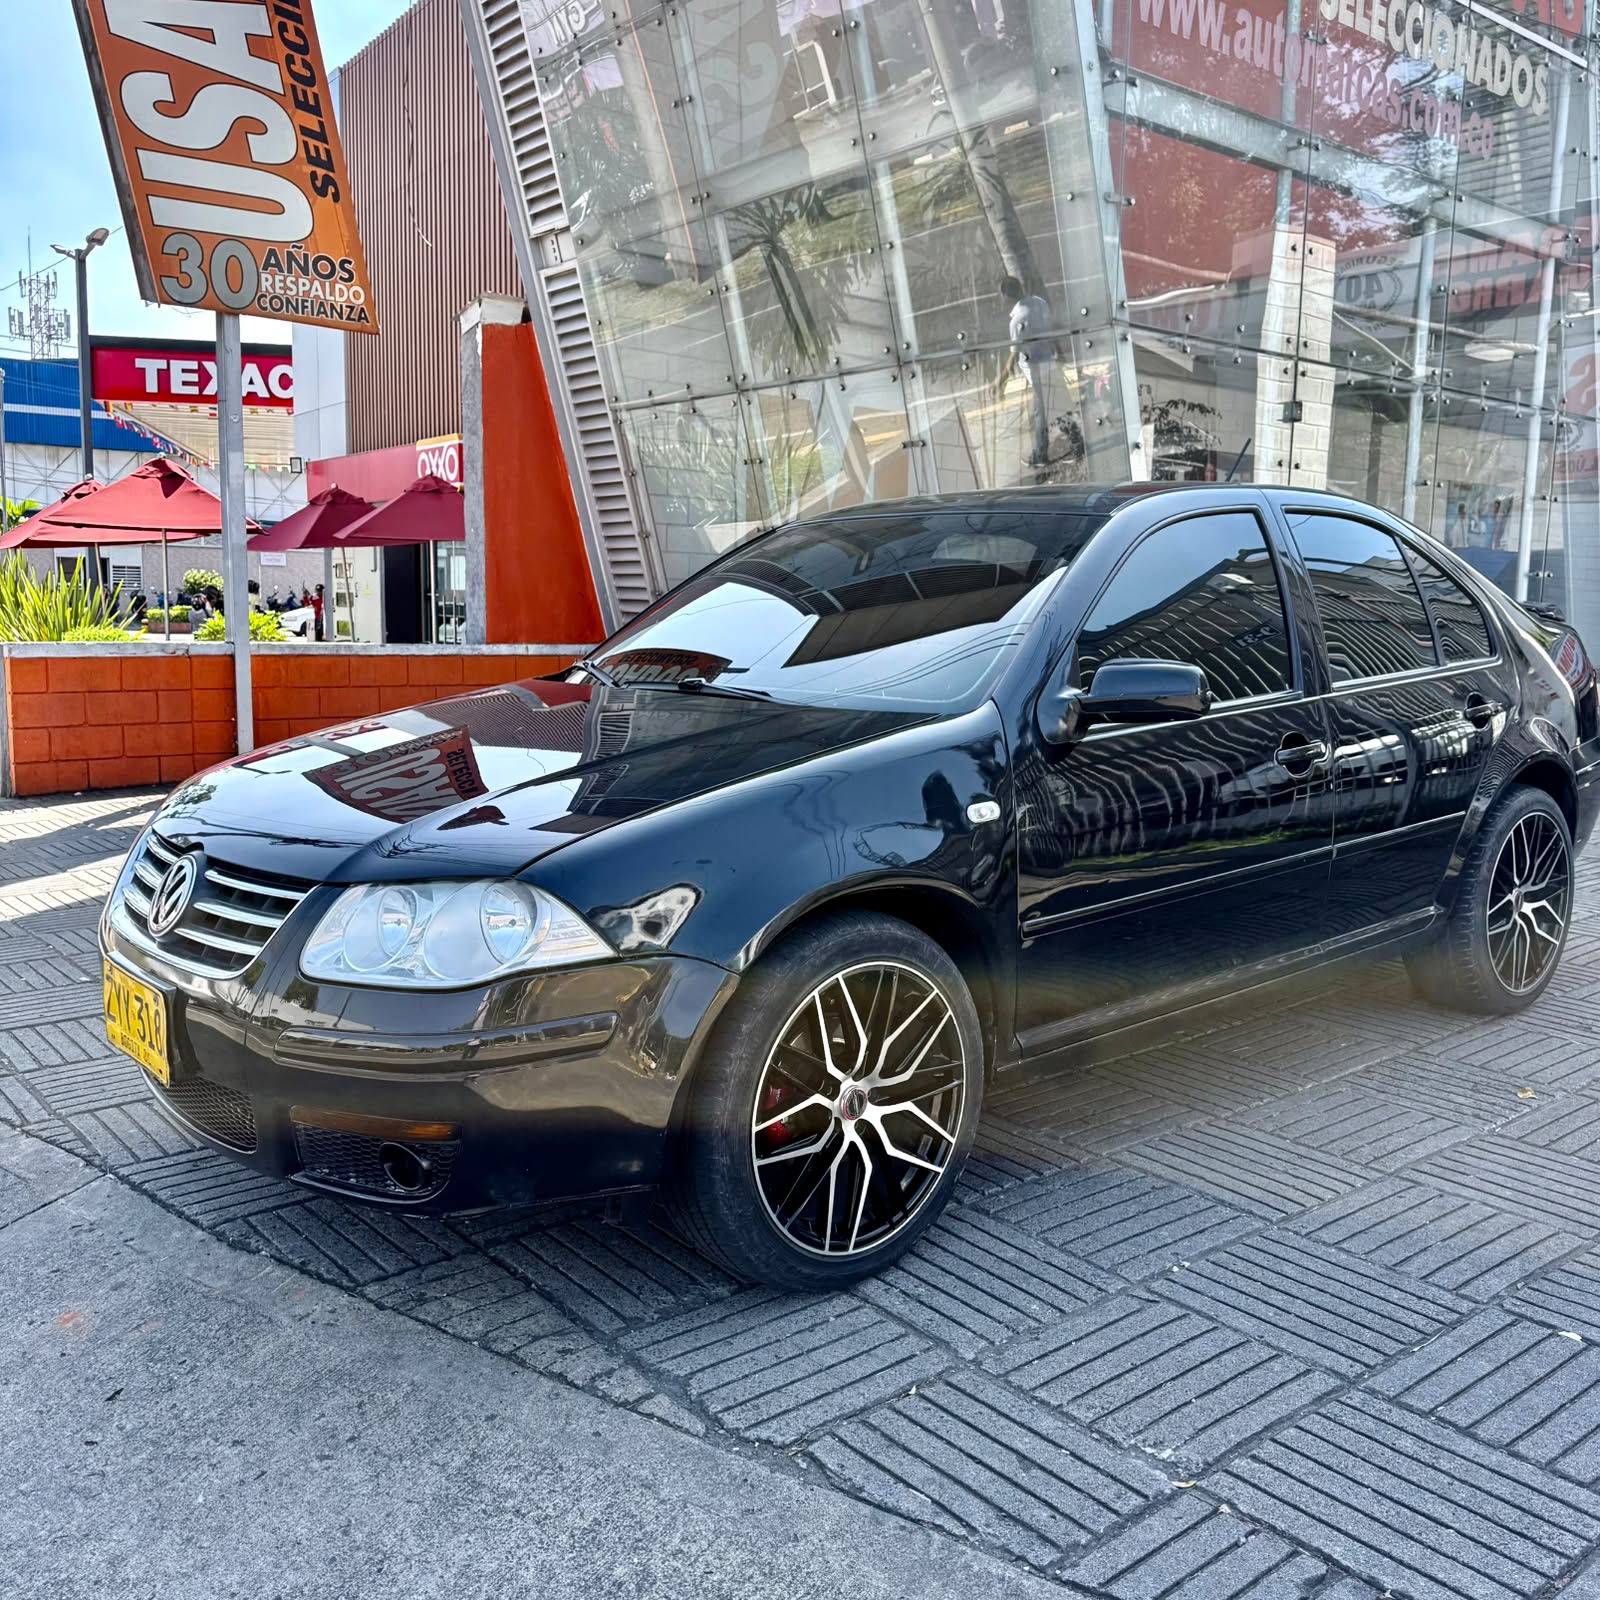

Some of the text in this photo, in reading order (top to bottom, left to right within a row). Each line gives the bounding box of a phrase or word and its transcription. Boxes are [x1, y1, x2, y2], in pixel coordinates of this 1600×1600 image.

[273, 0, 340, 203] SELECCI
[160, 232, 355, 309] 30 AÑOS
[260, 273, 365, 306] RESPALDO
[256, 293, 370, 324] CONFIANZA
[417, 445, 459, 481] OXXO
